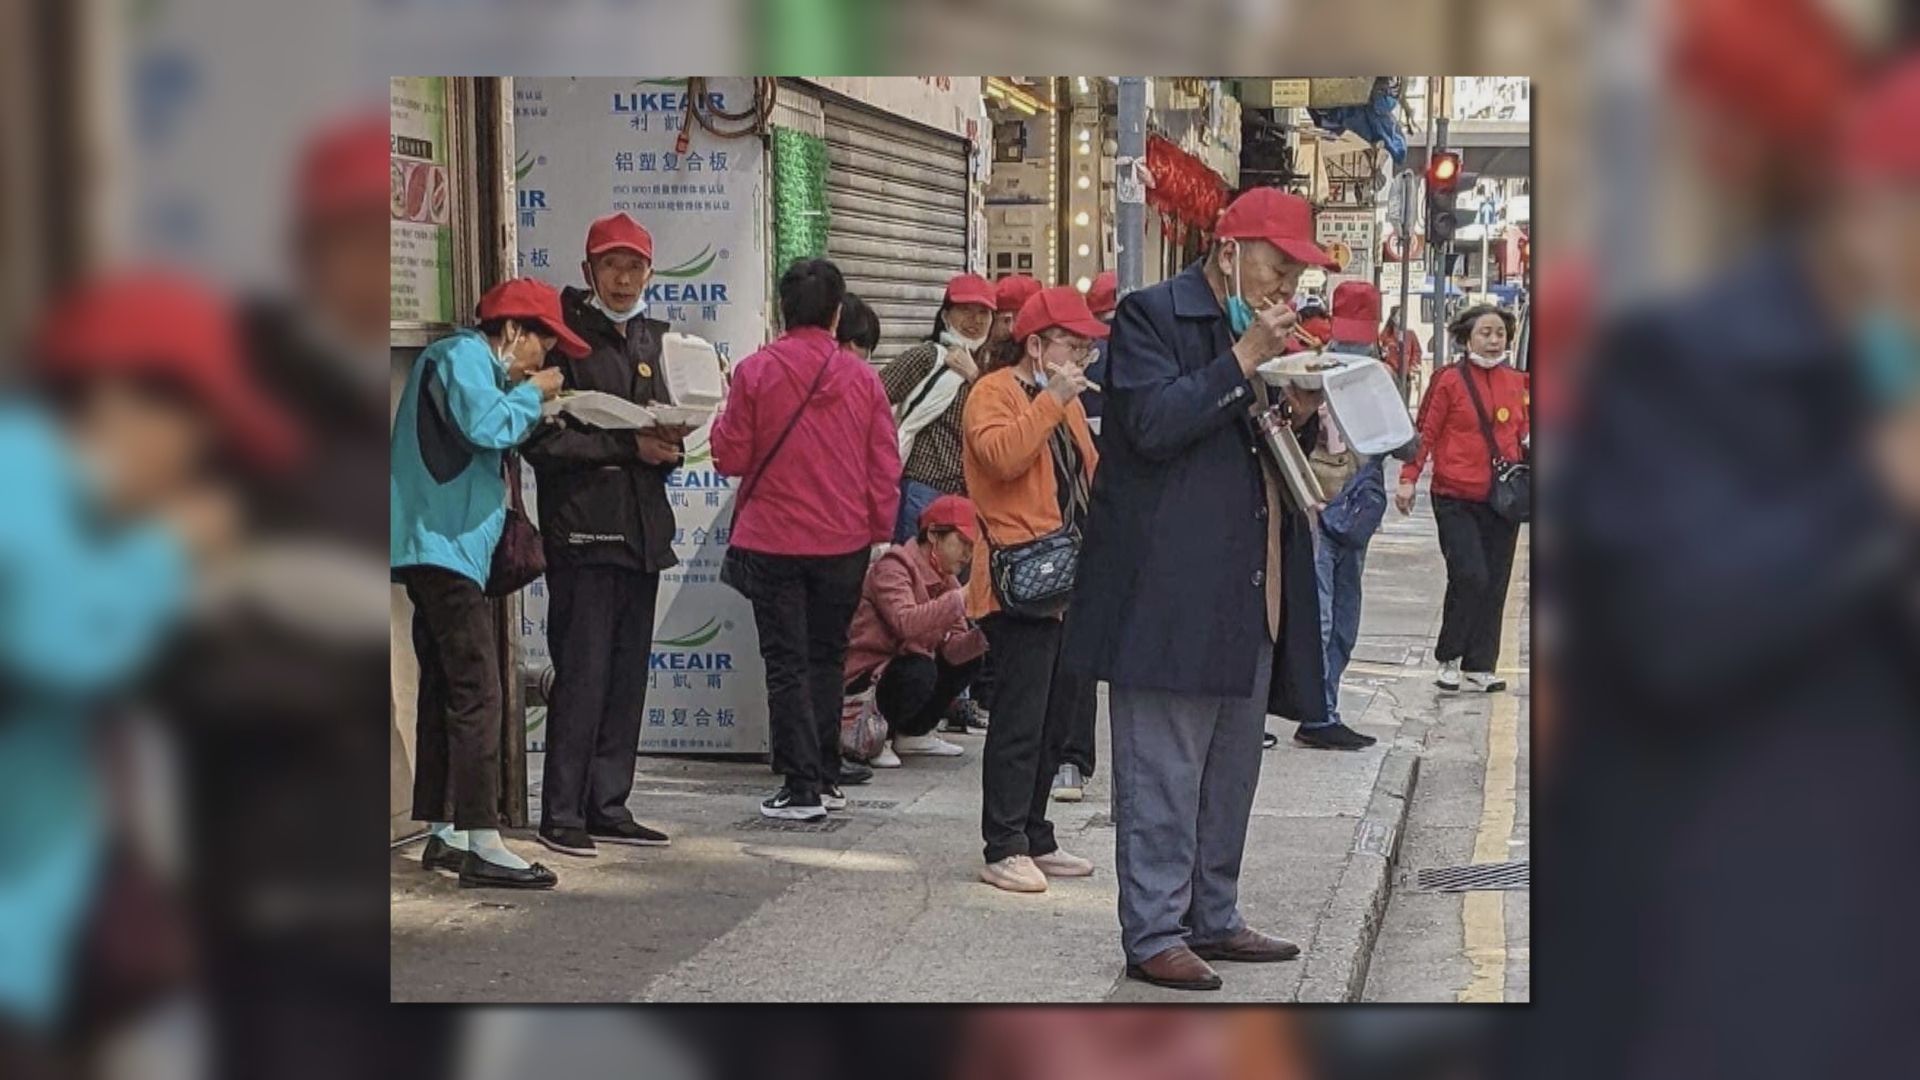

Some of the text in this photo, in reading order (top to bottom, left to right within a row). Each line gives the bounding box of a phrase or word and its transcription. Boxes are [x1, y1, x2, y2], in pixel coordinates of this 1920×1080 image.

[613, 93, 726, 112] LIKEAIR
[615, 152, 728, 171] 铝塑复合板
[649, 708, 735, 727] 塑复合板
